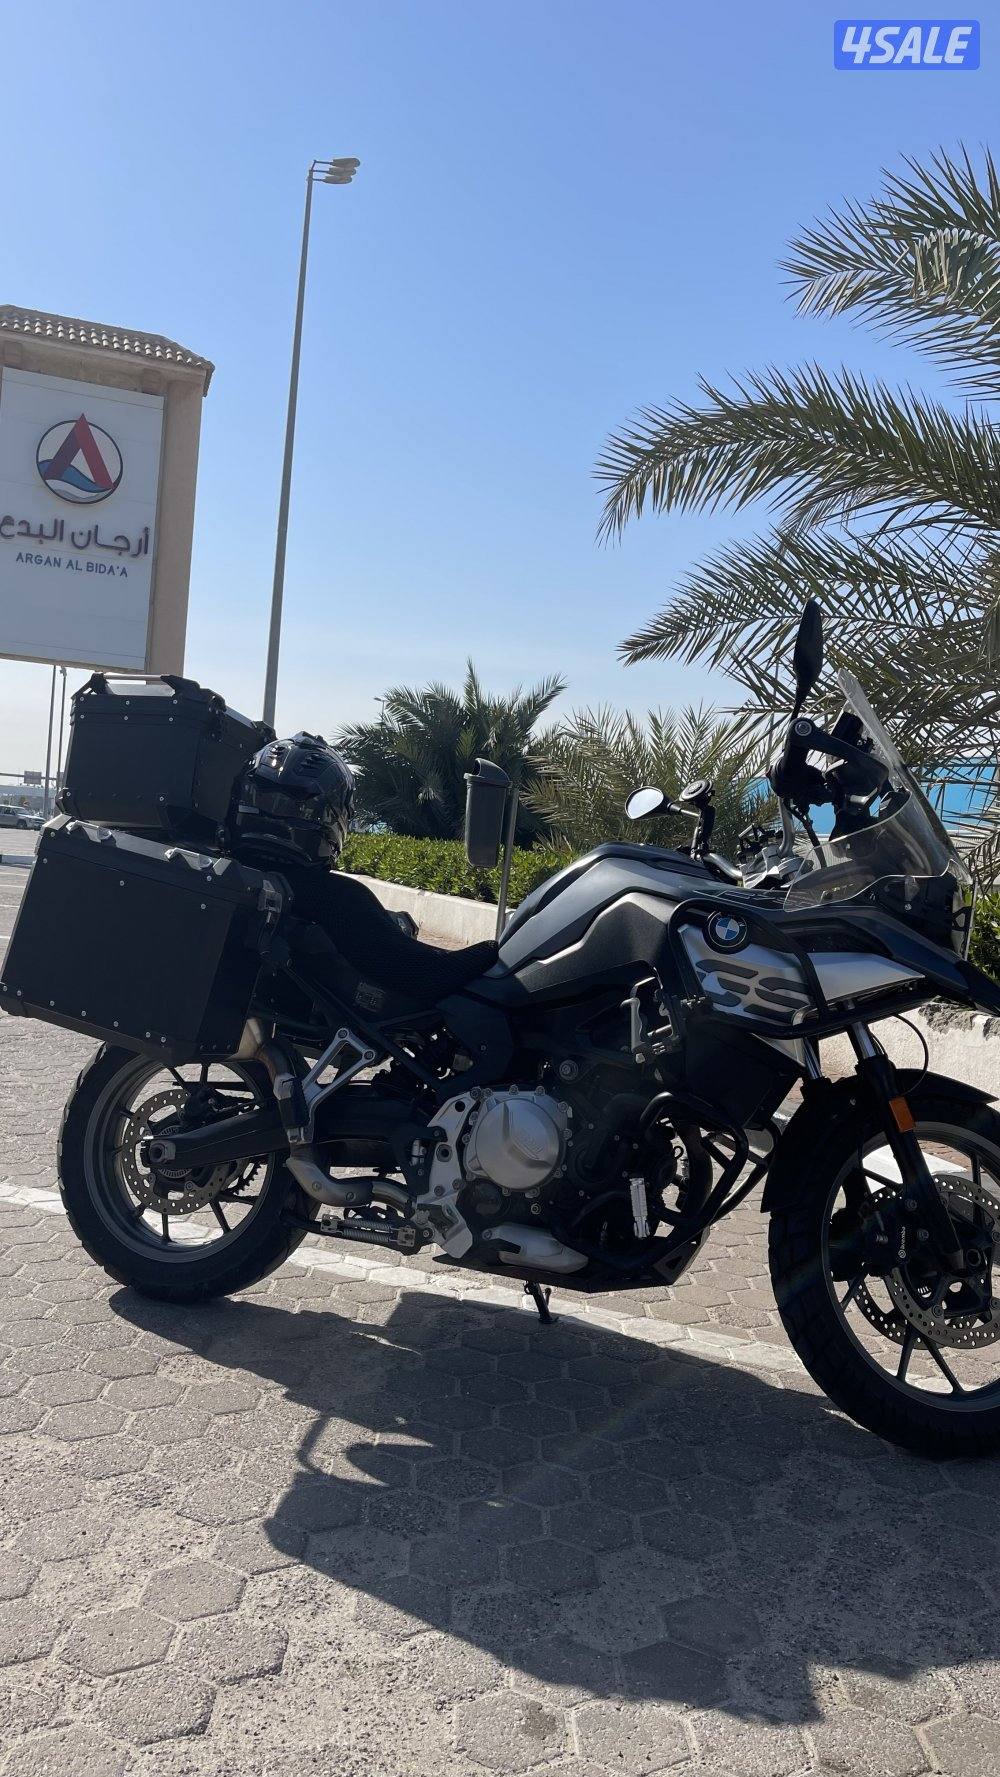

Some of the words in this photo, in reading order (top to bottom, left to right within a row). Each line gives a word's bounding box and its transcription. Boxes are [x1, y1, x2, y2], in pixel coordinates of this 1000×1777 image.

[0, 515, 65, 544] البدع
[71, 523, 150, 558] أرجان
[16, 552, 62, 569] ARGAN
[66, 559, 83, 572] AL
